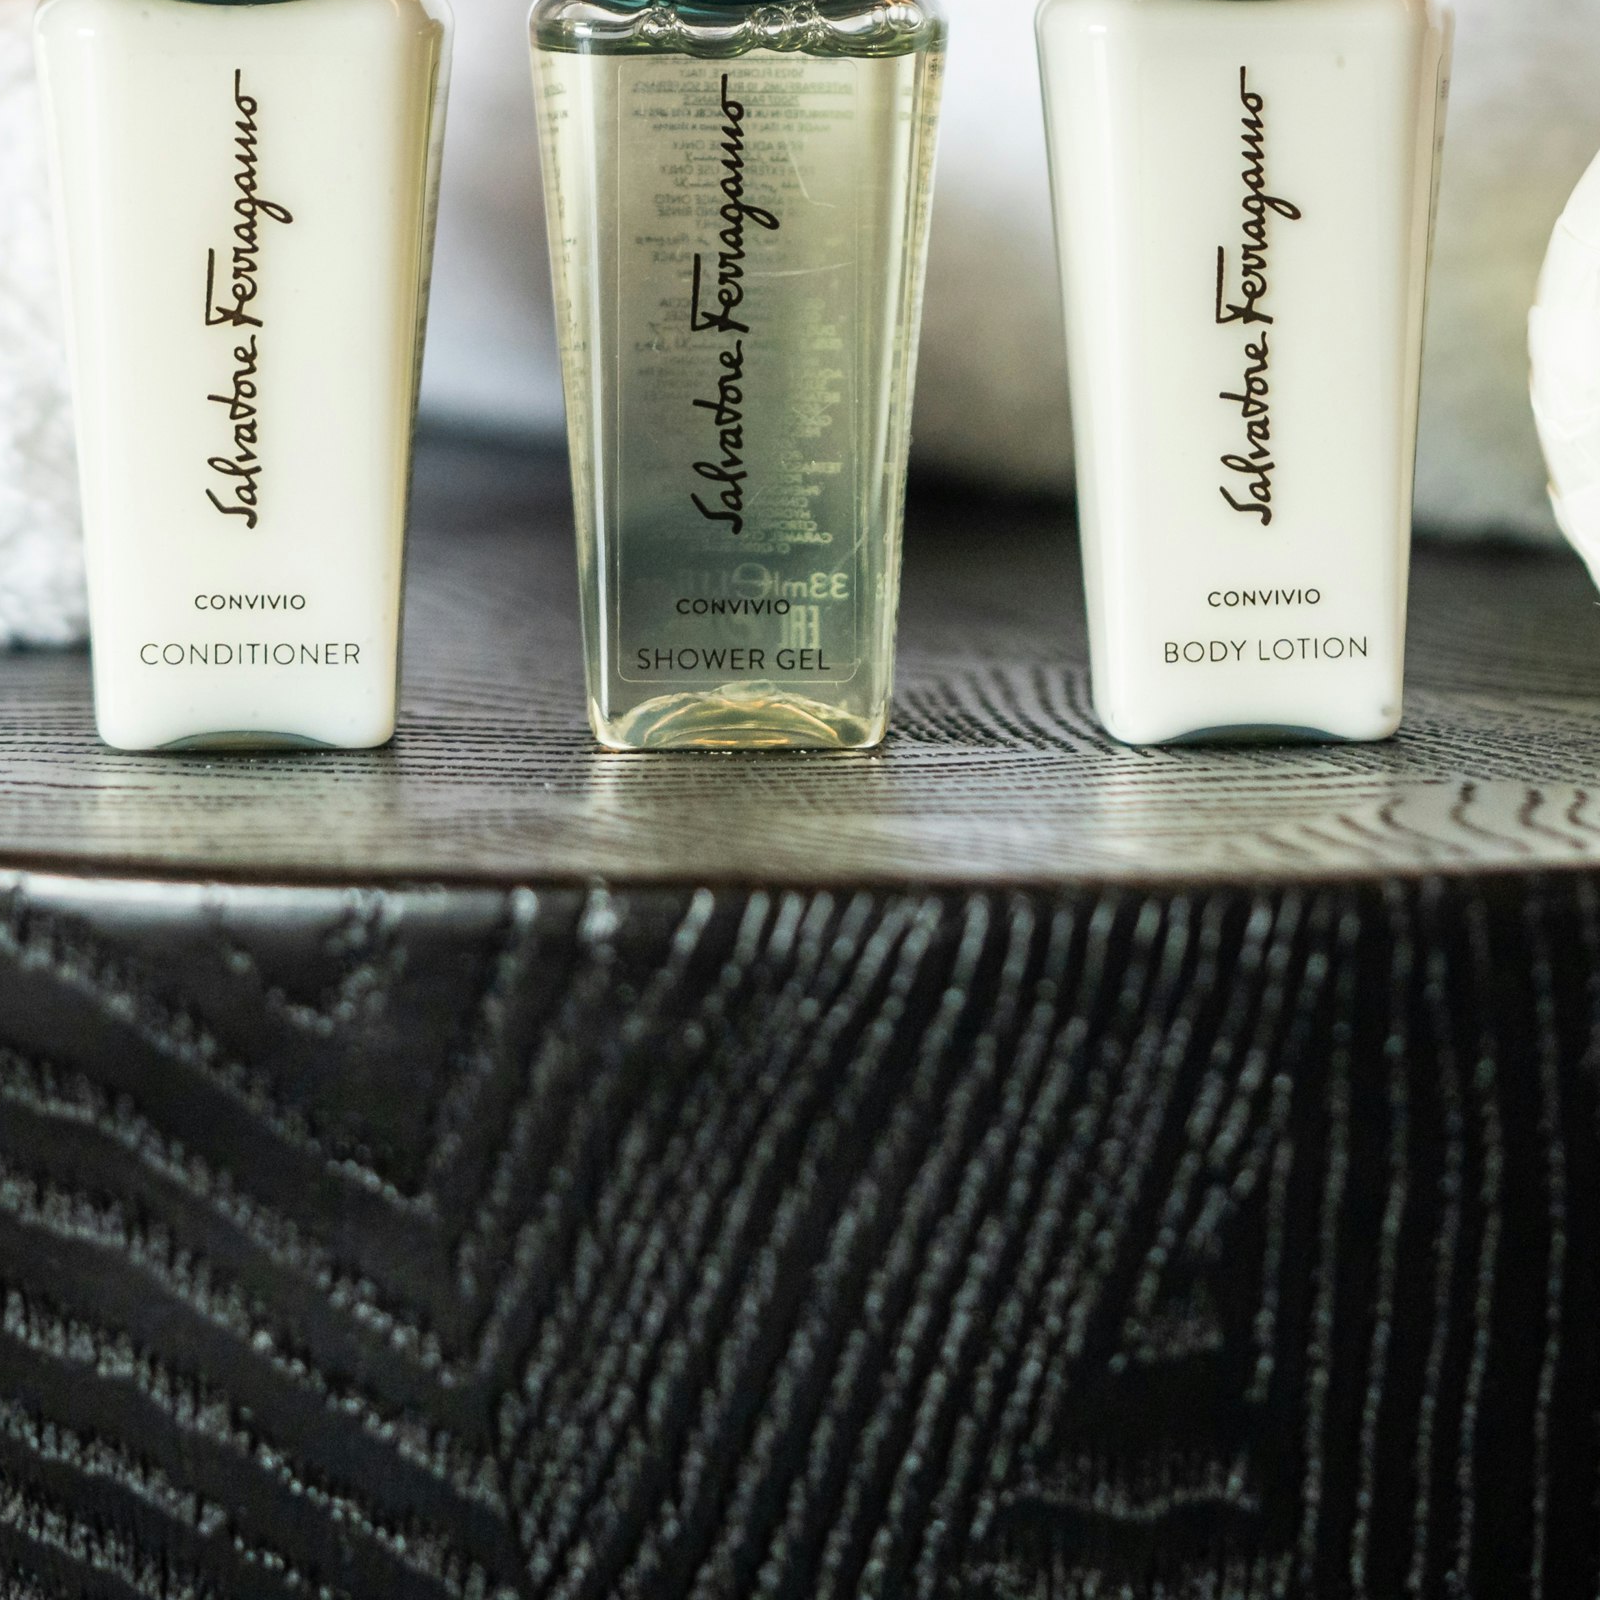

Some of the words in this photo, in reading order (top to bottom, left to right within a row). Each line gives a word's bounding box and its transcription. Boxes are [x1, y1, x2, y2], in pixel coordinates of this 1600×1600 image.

[205, 68, 293, 328] Ferragamo
[690, 73, 780, 334] Ferragamo
[1215, 65, 1302, 325] Ferragamo
[205, 334, 262, 530] Salvatore
[691, 339, 747, 536] Salvatore
[1219, 330, 1275, 526] Salvatore
[139, 643, 361, 665] CONDITIONER
[194, 594, 306, 610] CONVIVIO
[675, 598, 791, 615] CONVIVIO
[1164, 640, 1247, 664] BODY
[1258, 636, 1368, 661] LOTION
[1207, 588, 1321, 608] CONVIVIO
[637, 648, 765, 670] SHOWER
[776, 648, 831, 670] GEL
